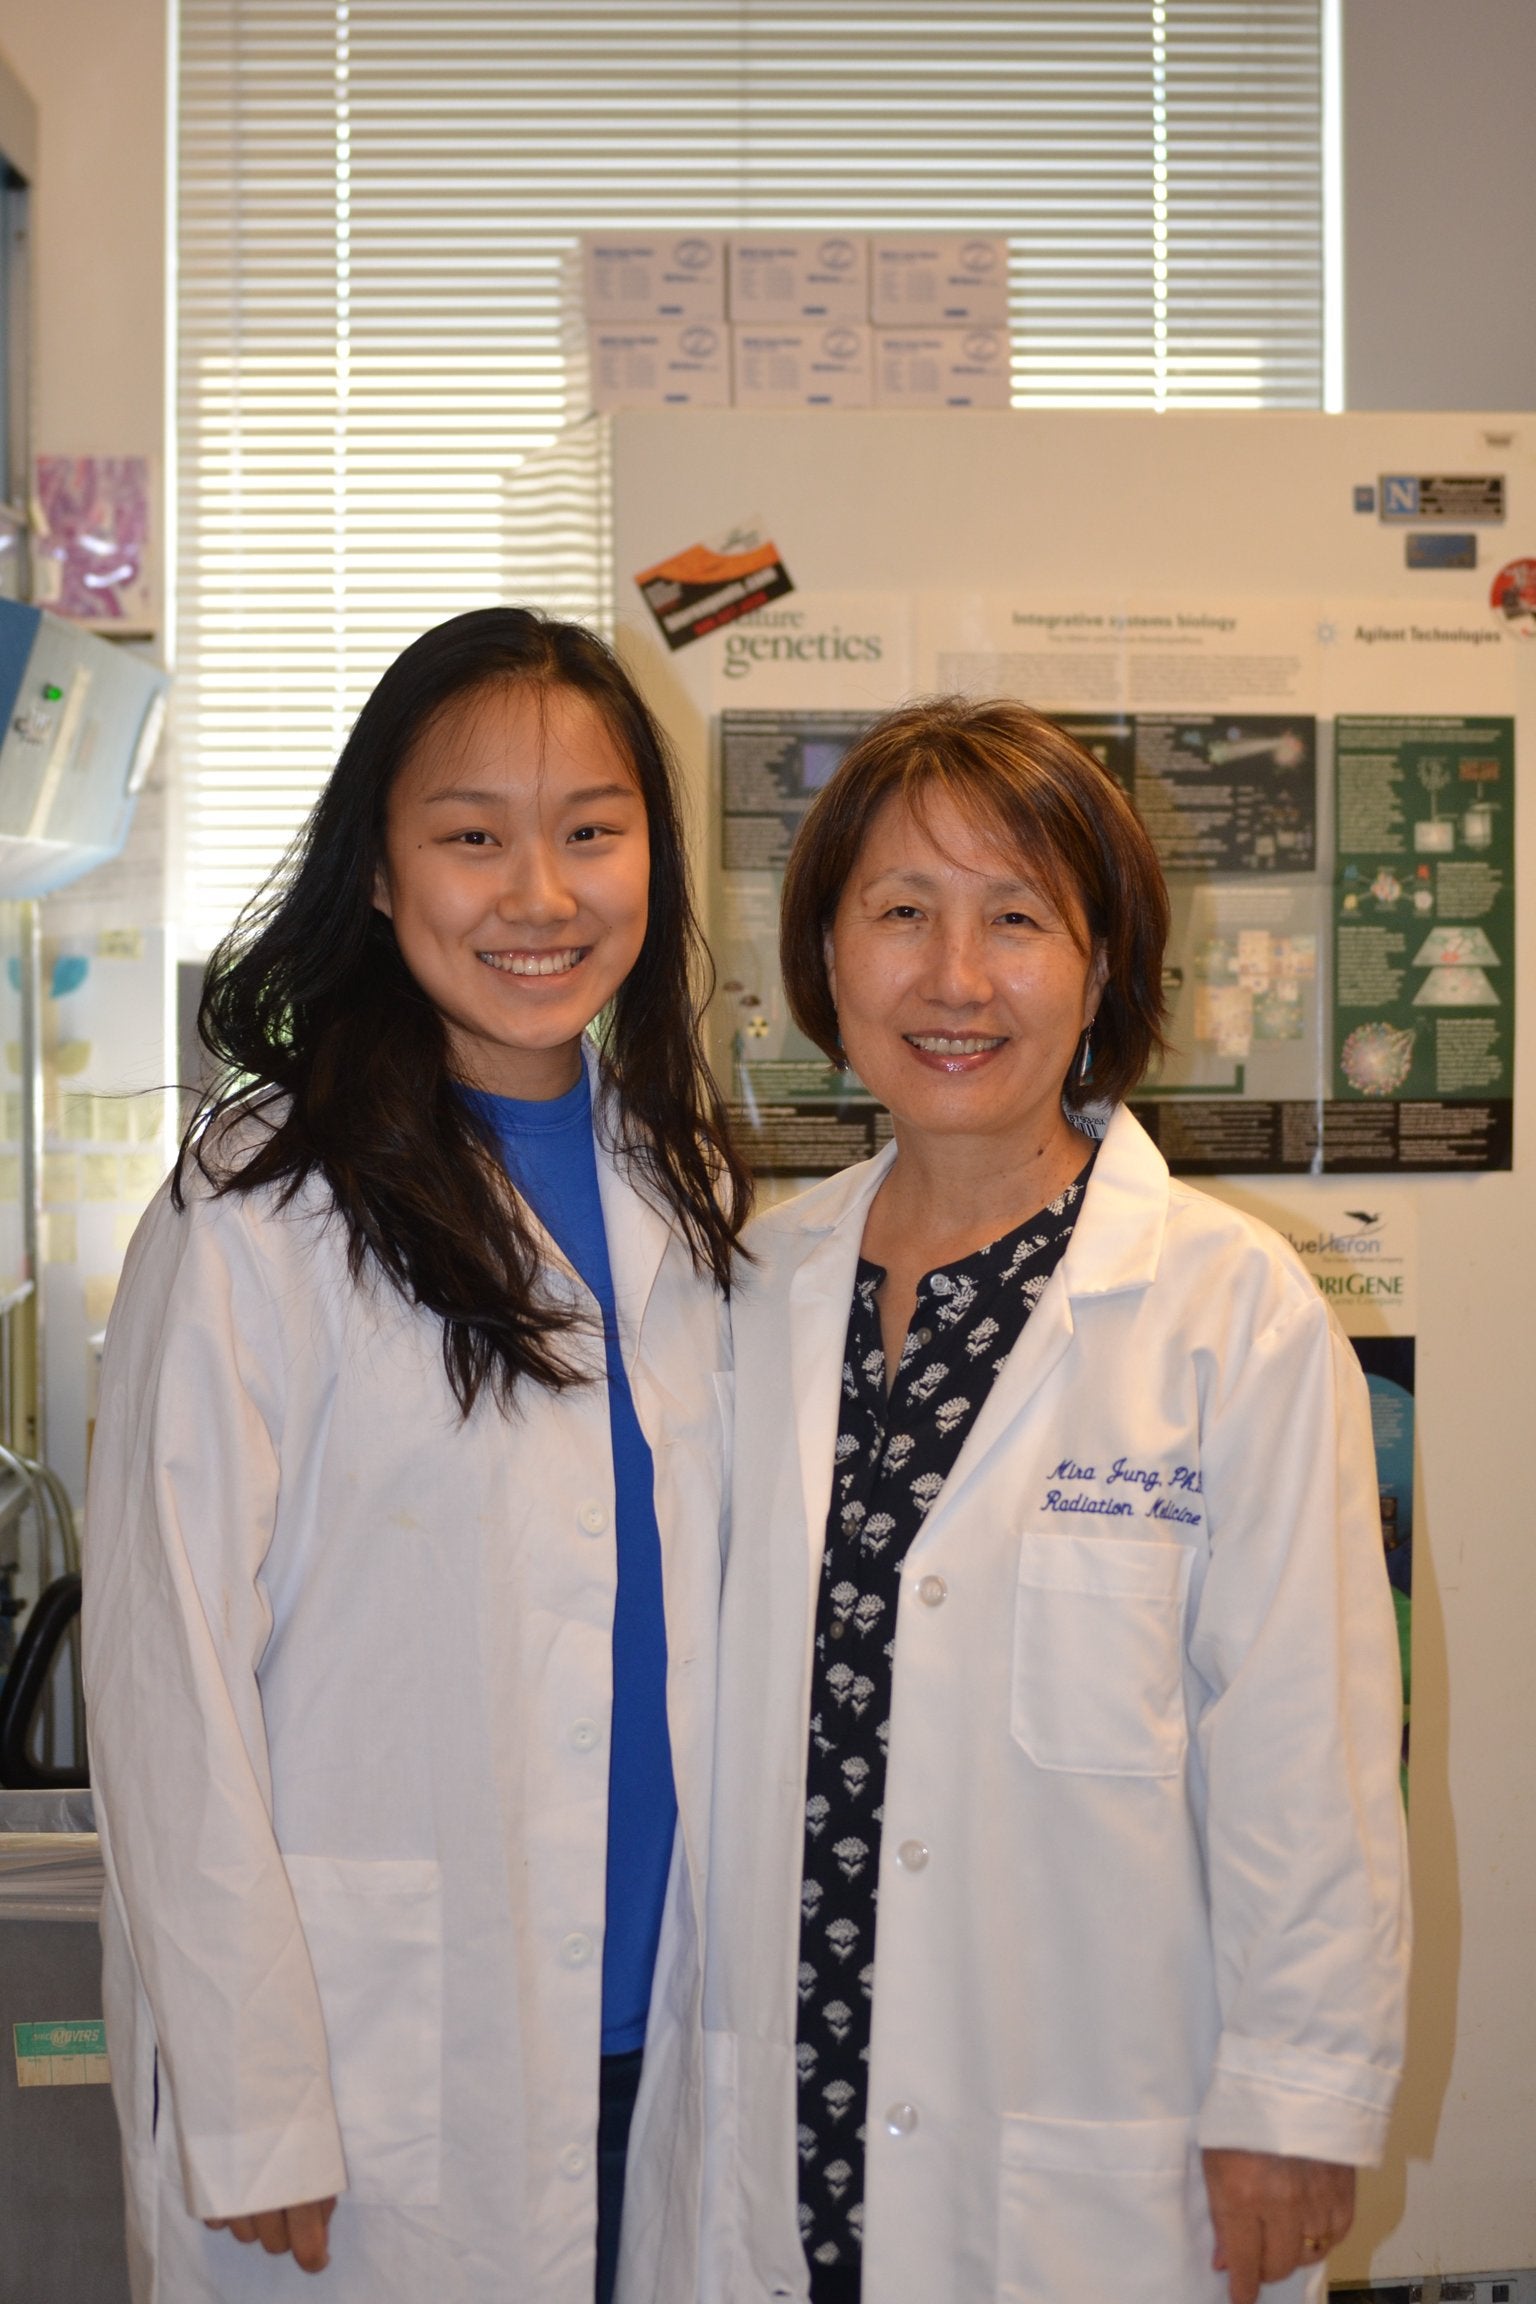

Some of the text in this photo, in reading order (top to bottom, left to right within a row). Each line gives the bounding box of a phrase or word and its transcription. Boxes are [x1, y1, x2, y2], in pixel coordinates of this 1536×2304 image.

[735, 608, 807, 628] ature
[1012, 611, 1237, 632] Integrative systems biology
[1354, 625, 1502, 645] Agilent Technologies
[723, 625, 883, 680] genetics
[1284, 1233, 1380, 1254] lueHeron
[1046, 1459, 1096, 1481] Mira
[1106, 1457, 1162, 1492] Jung,
[1040, 1489, 1202, 1526] Radiation Medicine
